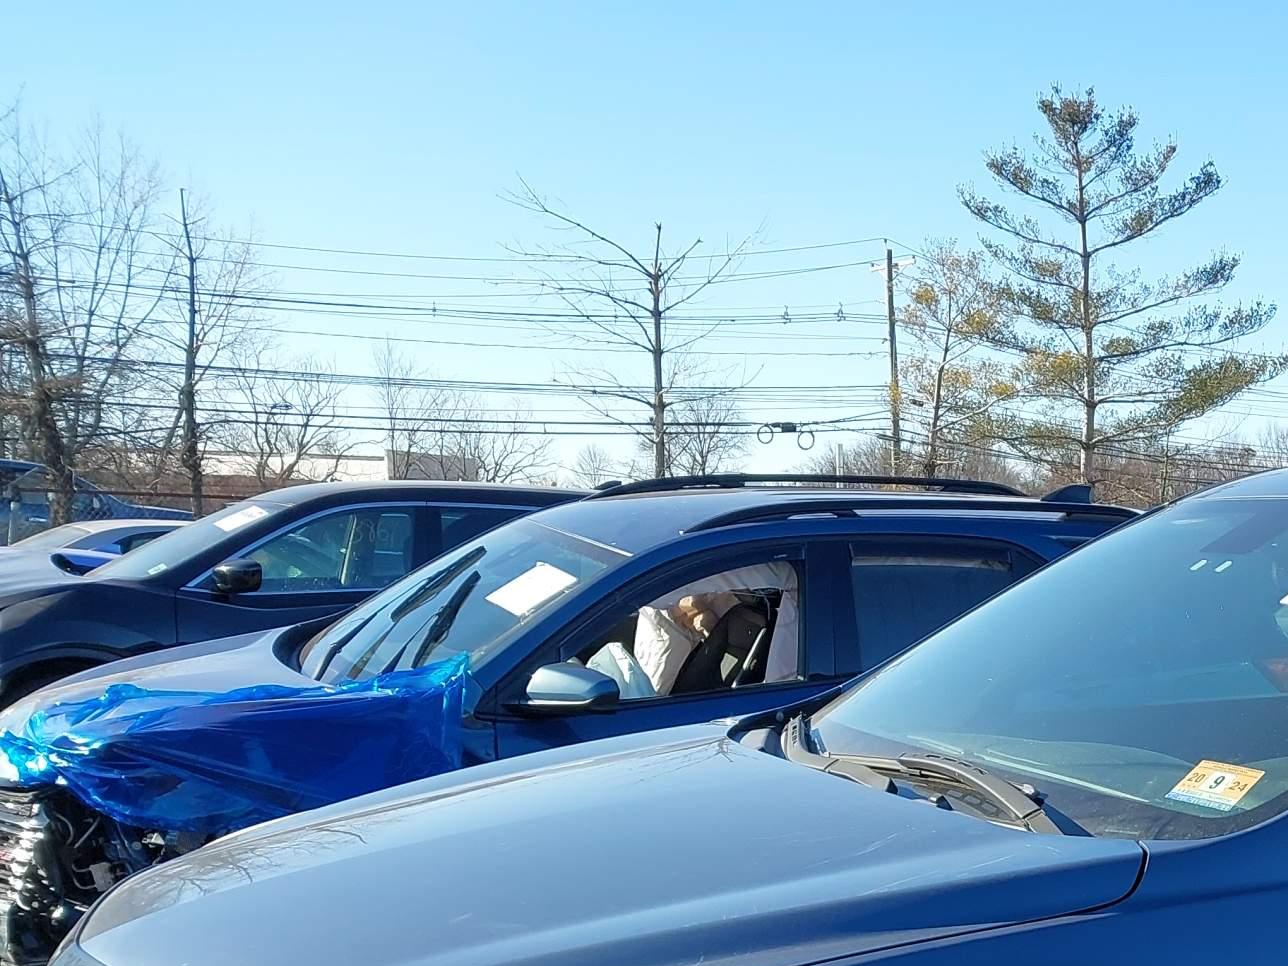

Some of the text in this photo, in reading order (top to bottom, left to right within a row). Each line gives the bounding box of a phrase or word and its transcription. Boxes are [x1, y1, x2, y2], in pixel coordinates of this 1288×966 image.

[1187, 772, 1249, 793] 20 9 24
